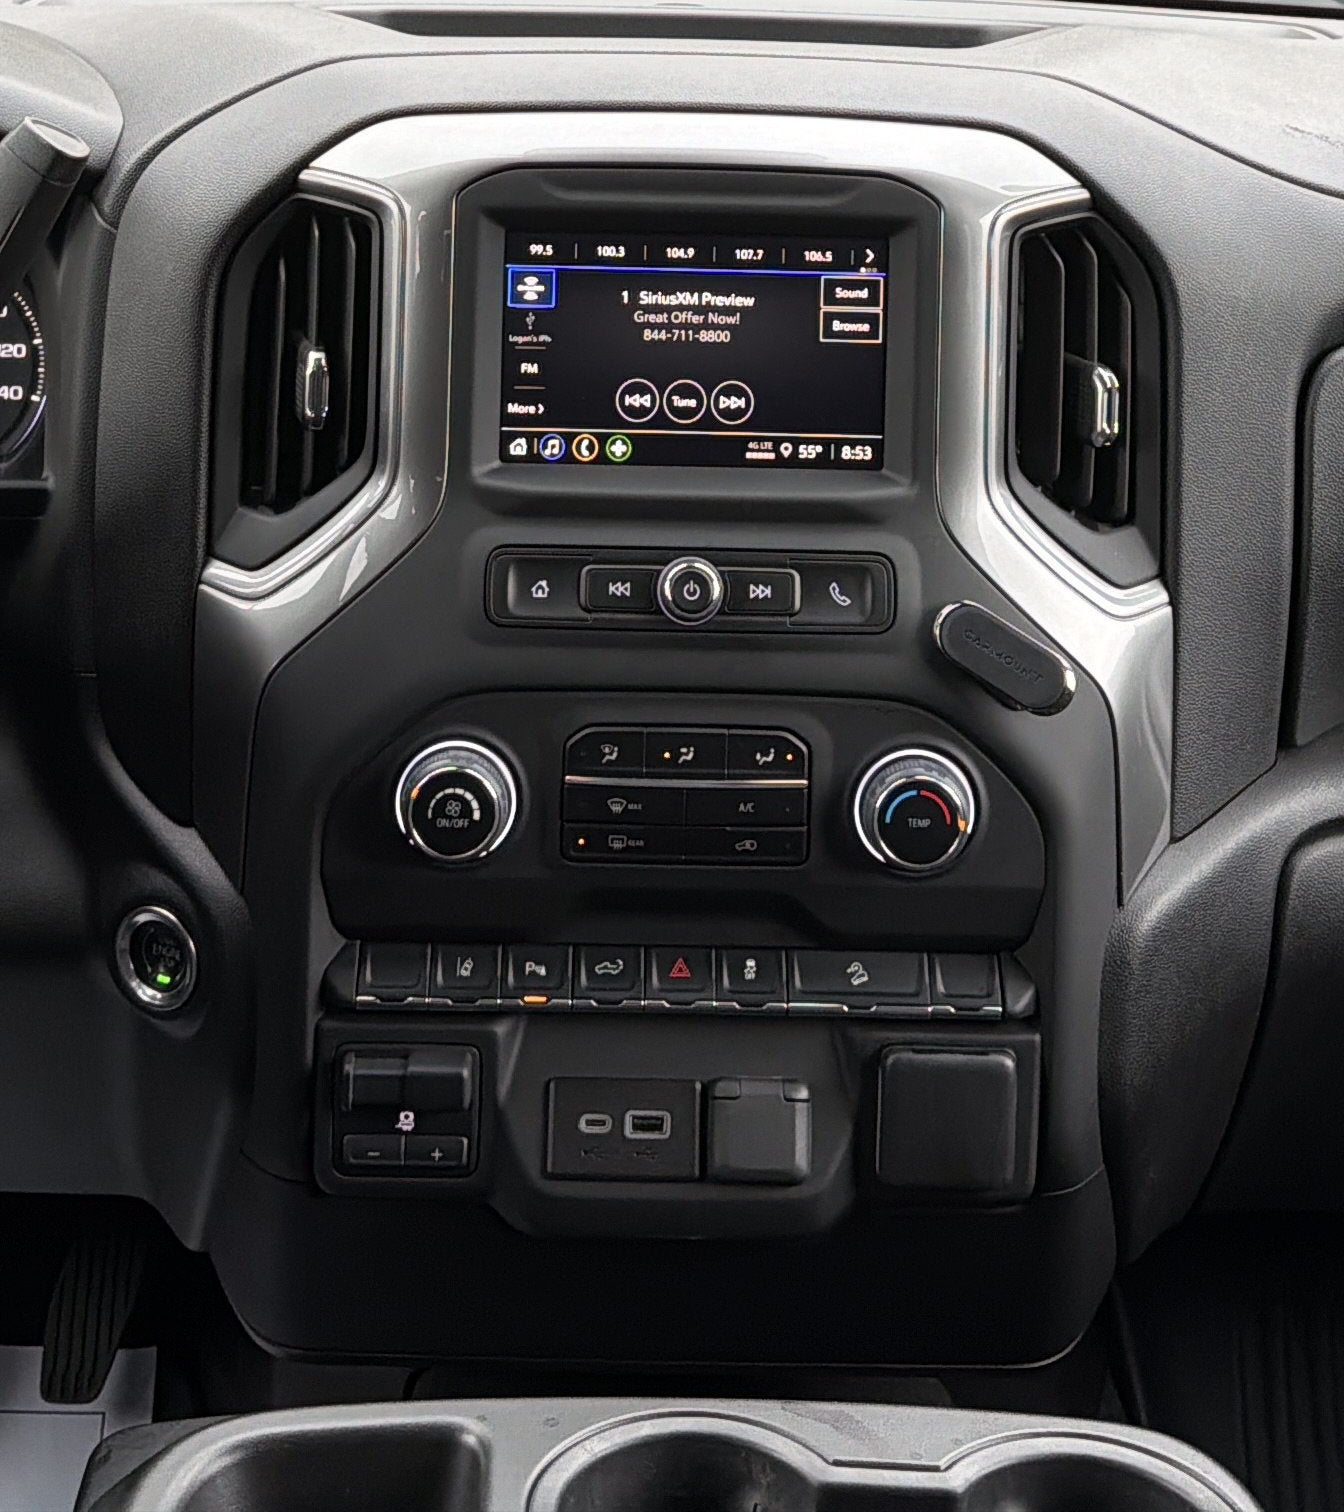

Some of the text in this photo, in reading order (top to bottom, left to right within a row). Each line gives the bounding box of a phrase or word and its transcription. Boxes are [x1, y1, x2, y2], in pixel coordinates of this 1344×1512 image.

[529, 244, 833, 262] 99.5 100.3 104.9 107.7 106.5
[621, 290, 755, 307] 1 SiriusXM Preview
[835, 287, 869, 299] Sound
[634, 310, 740, 325] Great Offer Now!
[832, 320, 870, 332] Browse
[643, 328, 731, 343] 844-711-8800
[520, 363, 538, 374] FM
[672, 396, 697, 407] Tune
[507, 403, 536, 414] More
[759, 442, 774, 450] LTE
[841, 445, 872, 460] 8:53
[739, 803, 755, 813] A/C
[436, 818, 470, 828] ON/OFF
[907, 818, 931, 828] TEMP
